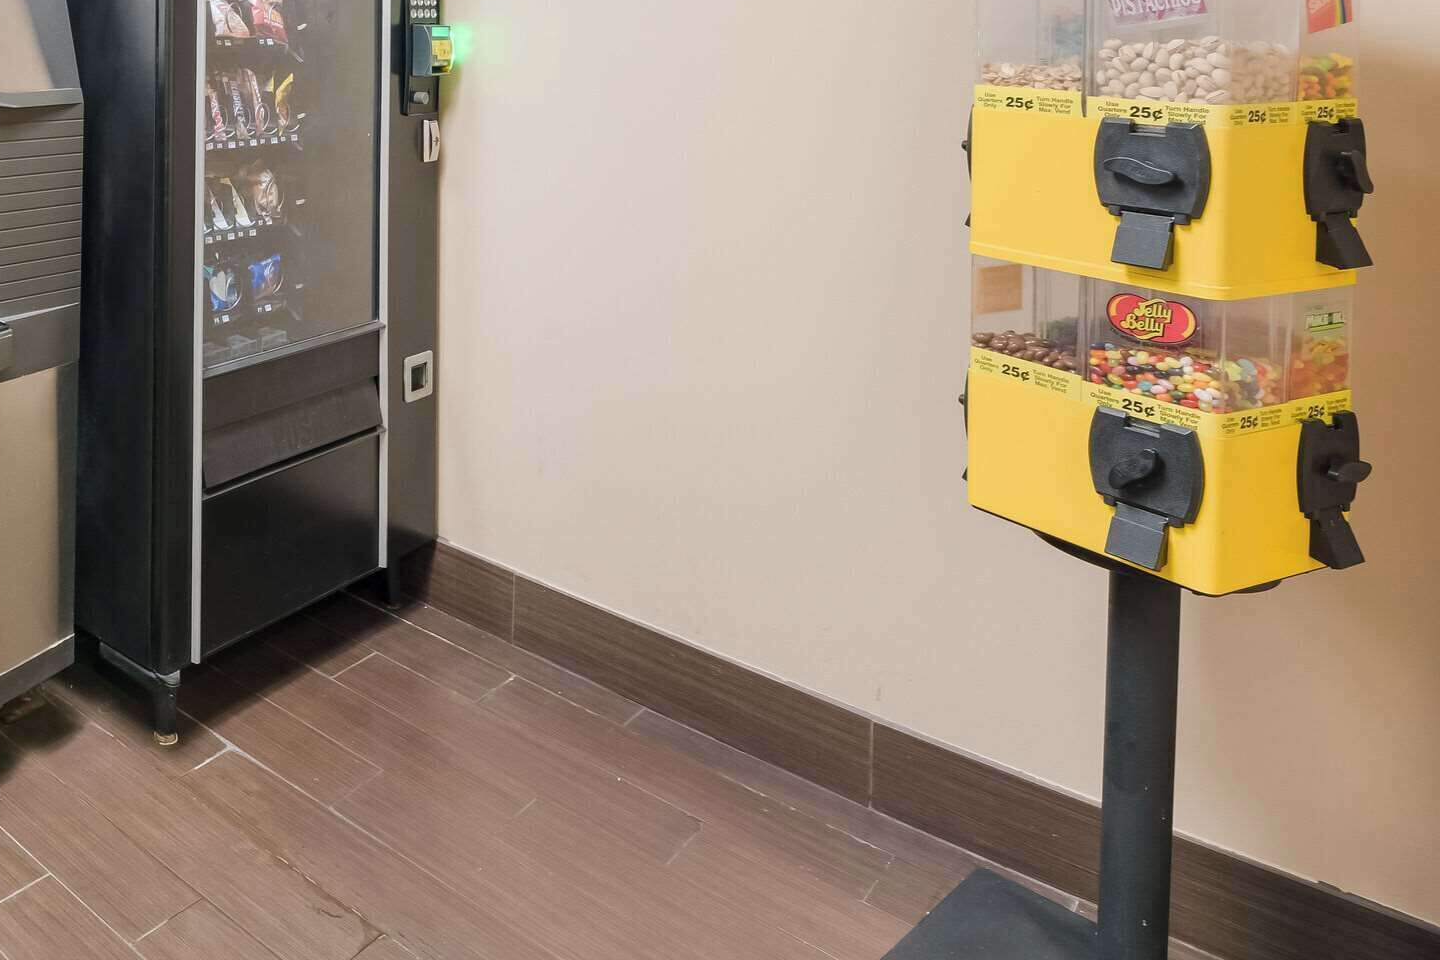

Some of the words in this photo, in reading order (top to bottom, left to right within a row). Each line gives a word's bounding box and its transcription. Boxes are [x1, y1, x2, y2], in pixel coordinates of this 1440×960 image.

[1005, 96, 1034, 110] 25¢
[1129, 106, 1163, 121] 25¢
[1248, 110, 1266, 124] 25¢
[1317, 106, 1334, 119] 25¢
[1133, 301, 1173, 324] Jelly
[1120, 313, 1165, 337] Belly
[1001, 363, 1030, 381] 25¢
[1121, 398, 1155, 417] 25¢
[1307, 405, 1325, 419] 25¢
[1240, 415, 1258, 429] 25¢
